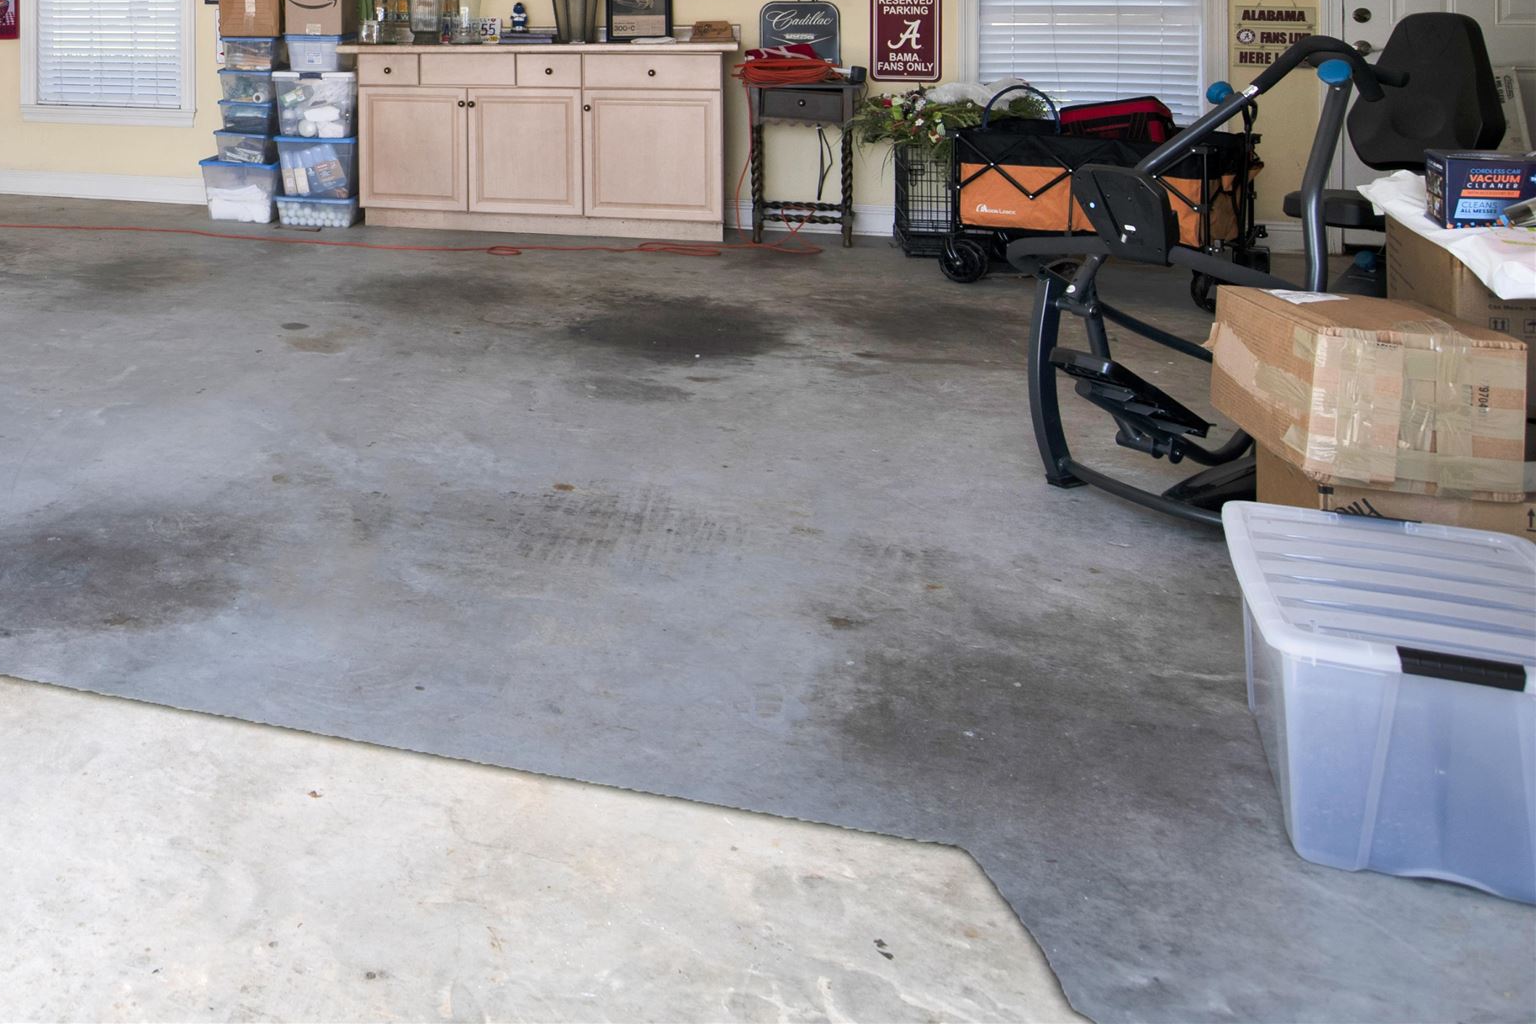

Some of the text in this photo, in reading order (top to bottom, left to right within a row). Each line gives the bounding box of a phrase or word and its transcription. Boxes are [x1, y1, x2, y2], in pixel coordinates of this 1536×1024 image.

[884, 6, 929, 15] PARKING
[766, 10, 834, 31] Cadillac
[1242, 10, 1306, 22] ALABAMA
[1260, 31, 1287, 44] FANS
[889, 53, 920, 62] BAMA
[1239, 51, 1271, 64] HERE
[877, 62, 934, 71] FANS ONLY
[1469, 175, 1521, 183] VACUUM
[1461, 201, 1498, 209] CLEANS
